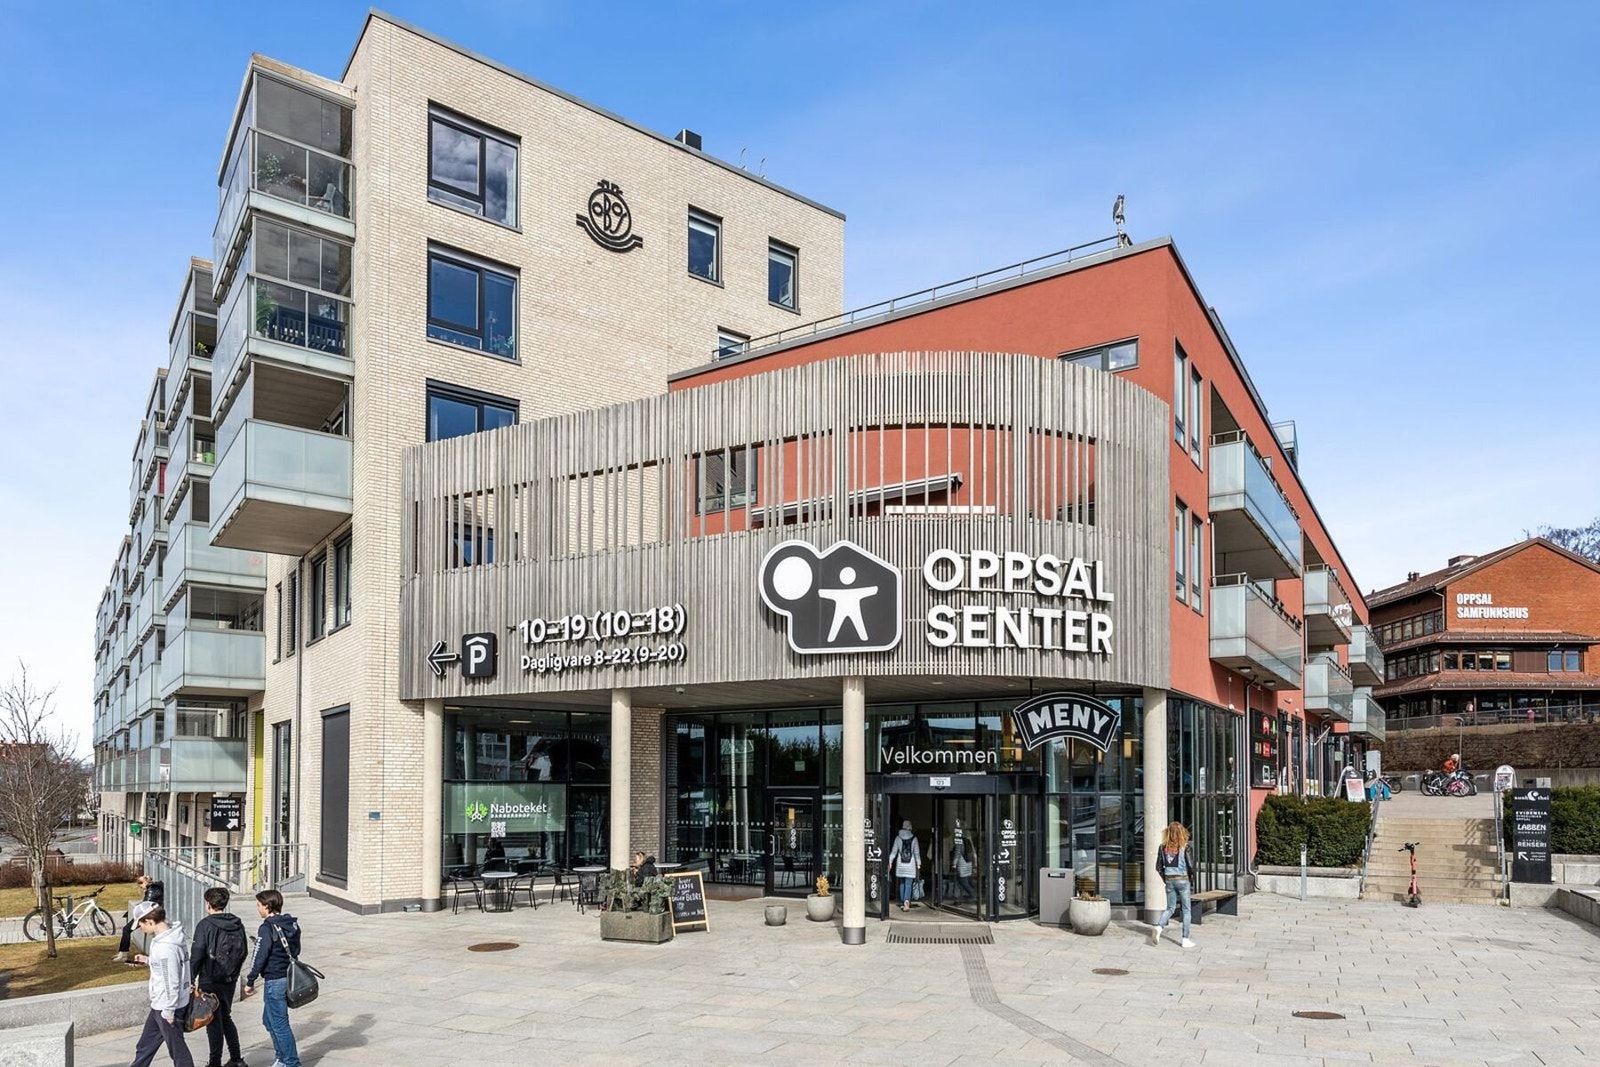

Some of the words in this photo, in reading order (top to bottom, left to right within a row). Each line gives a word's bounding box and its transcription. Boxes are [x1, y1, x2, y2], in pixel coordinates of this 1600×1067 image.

[923, 548, 1115, 602] OPPSAL
[1456, 593, 1493, 605] OPPSAL
[1456, 606, 1529, 619] SAMFUNNSHUS
[926, 604, 1114, 655] SENTER
[470, 645, 487, 675] P
[520, 653, 592, 673] Dagligvare
[1027, 703, 1111, 735] MENY
[881, 746, 998, 765] Velkommen
[490, 802, 548, 814] Naboteket
